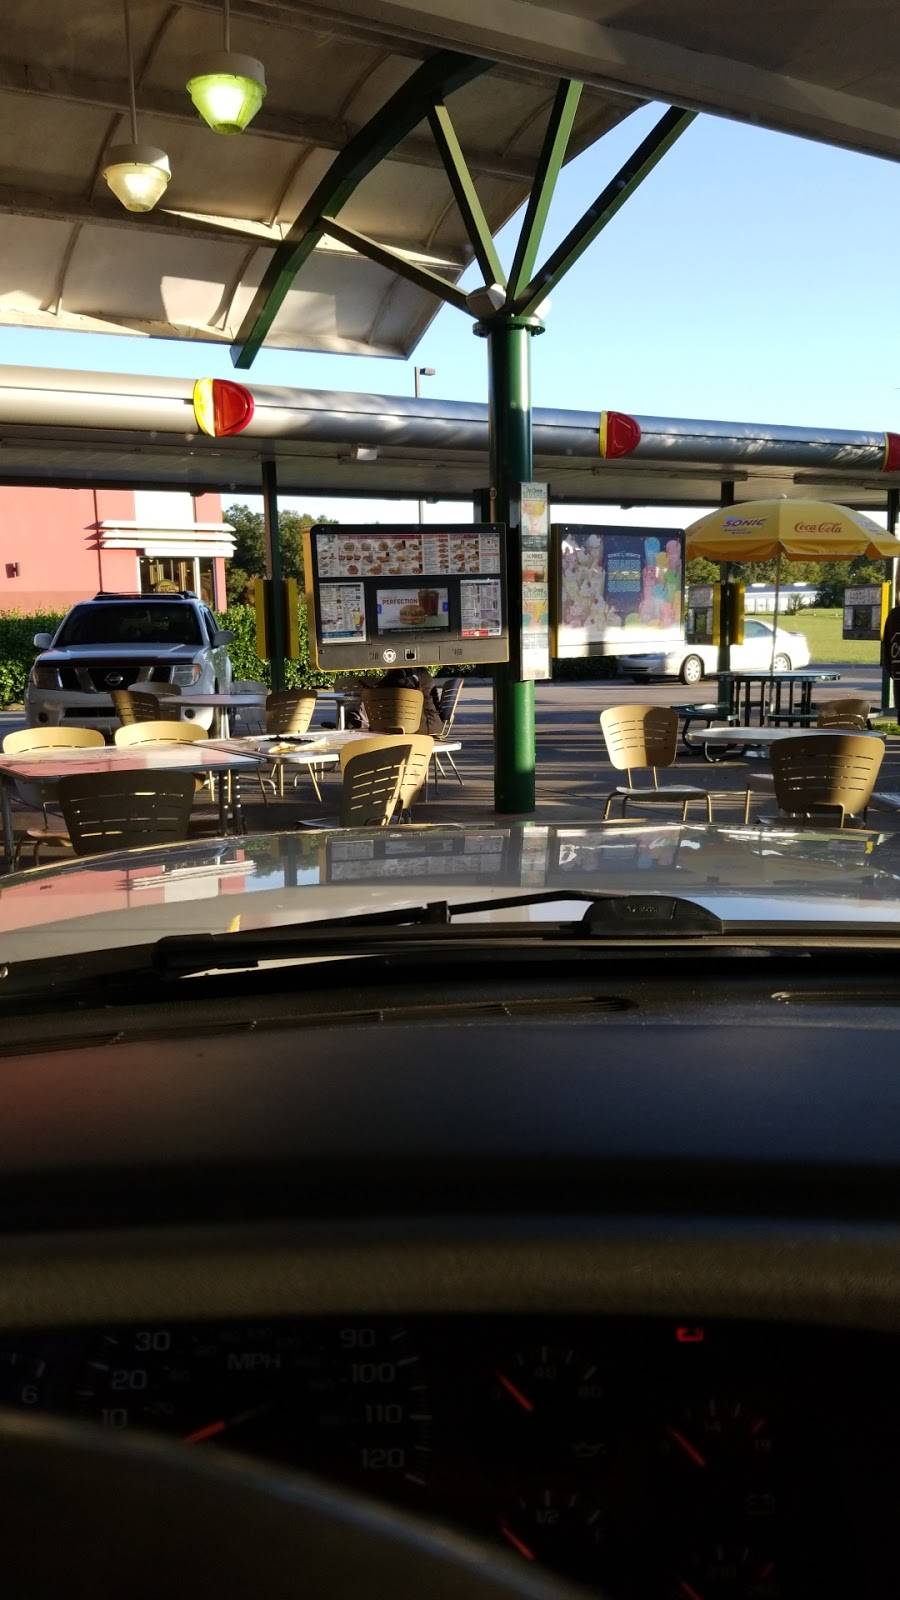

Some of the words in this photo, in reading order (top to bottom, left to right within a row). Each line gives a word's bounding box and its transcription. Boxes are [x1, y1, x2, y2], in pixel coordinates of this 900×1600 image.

[722, 518, 767, 527] SONIC
[135, 1331, 171, 1352] 30
[339, 1328, 376, 1349] 90
[226, 1352, 281, 1370] MPH
[110, 1369, 148, 1391] 20
[351, 1362, 396, 1384] 100
[21, 1384, 39, 1405] 6
[101, 1408, 128, 1430] 10
[364, 1402, 403, 1425] 110
[360, 1447, 406, 1469] 120
